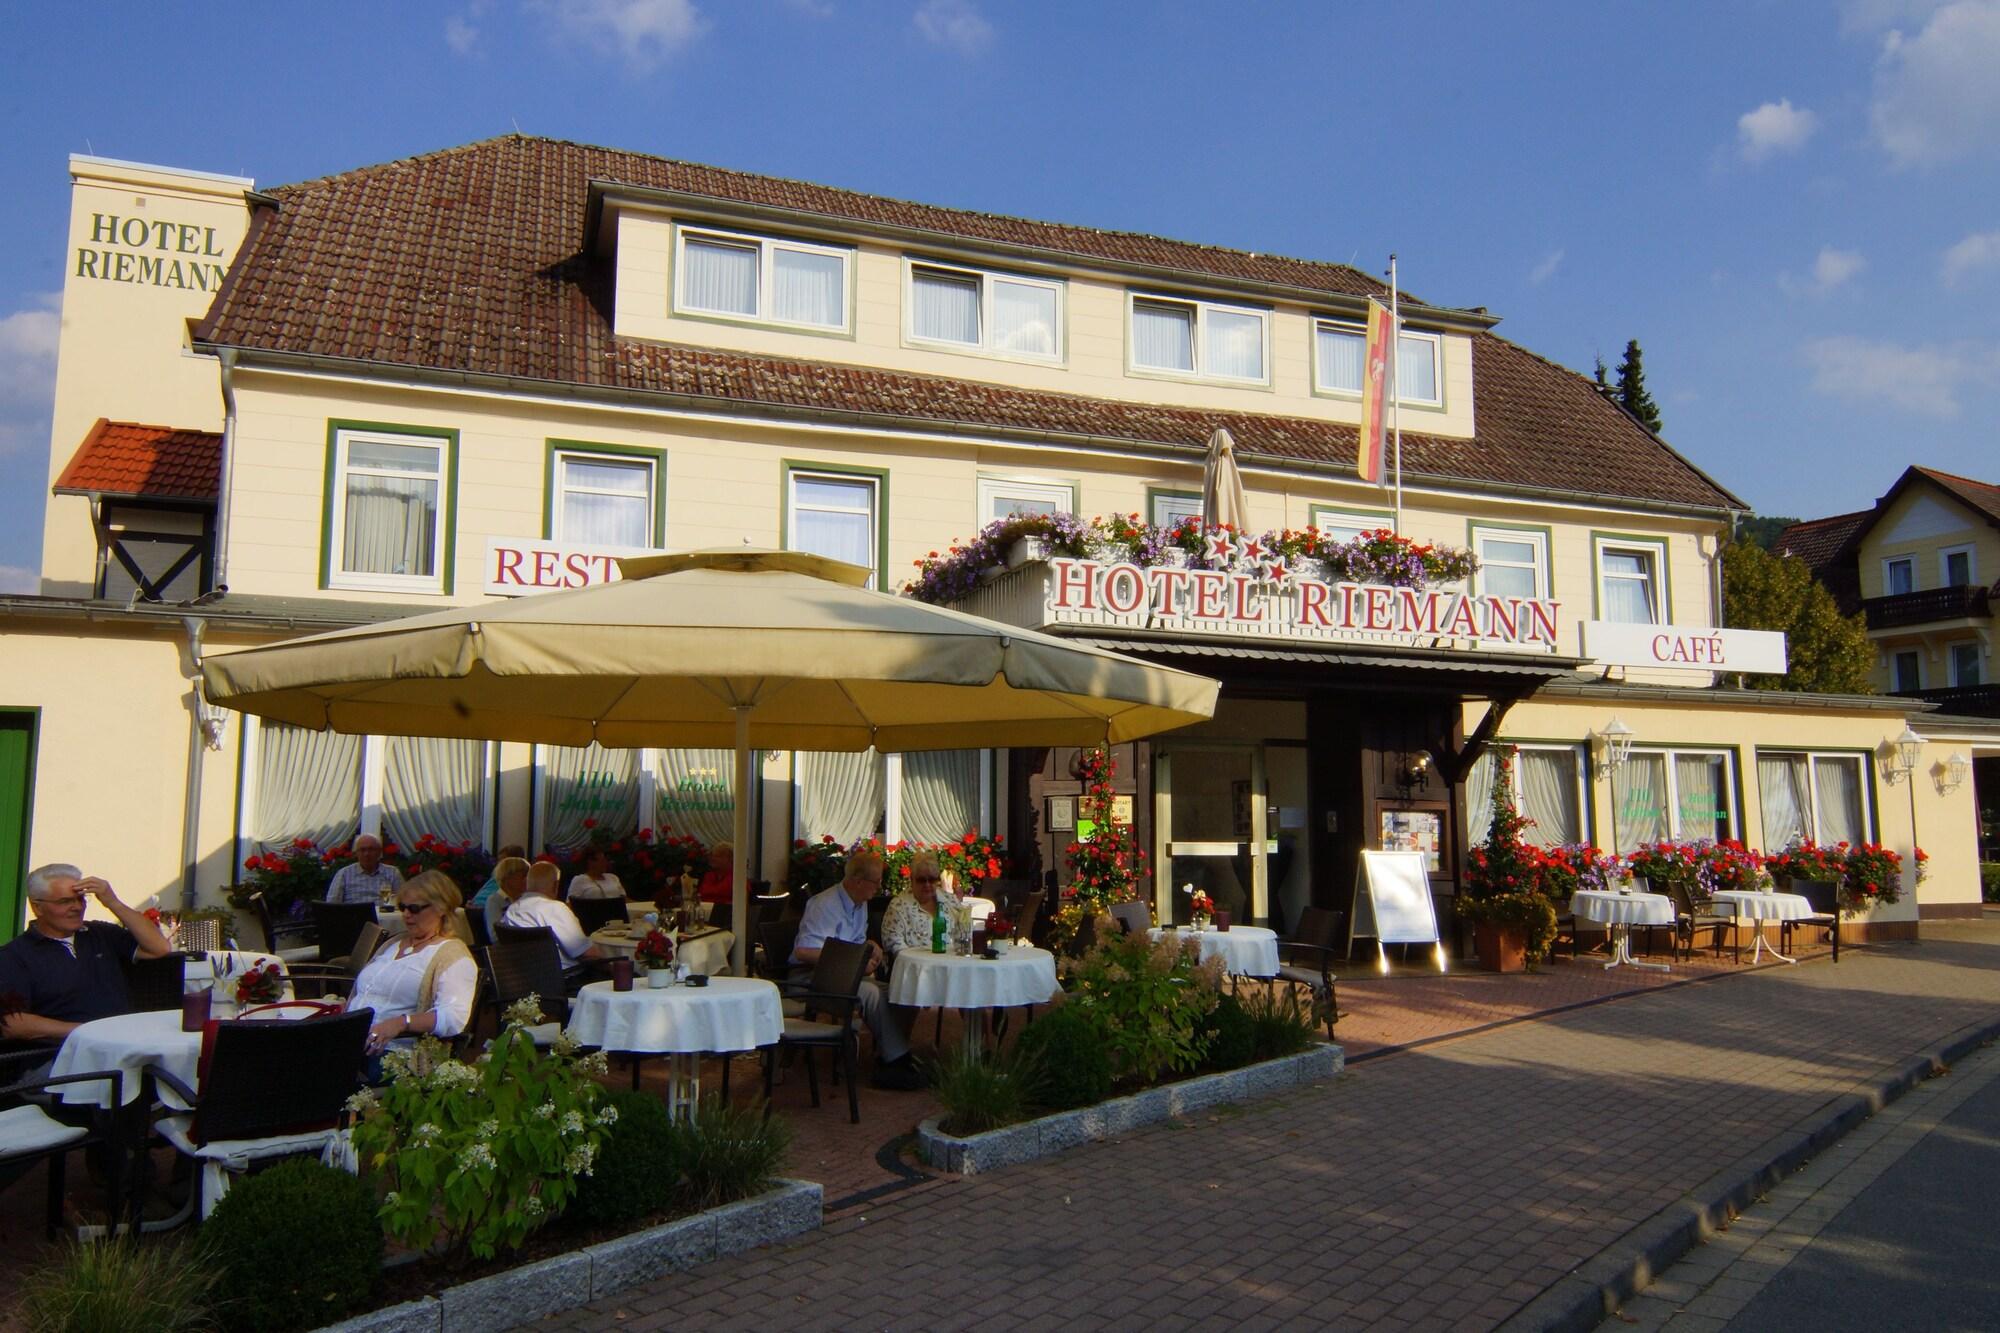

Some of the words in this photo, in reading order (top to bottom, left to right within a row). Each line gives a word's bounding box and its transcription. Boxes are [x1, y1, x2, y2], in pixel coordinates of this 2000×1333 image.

[90, 213, 224, 258] HOTEL
[492, 548, 624, 589] REST
[1054, 561, 1265, 622] HOTEL
[1297, 582, 1562, 642] RIEMANN
[1651, 630, 1725, 664] CAFÉ
[576, 769, 615, 789] 110
[678, 777, 727, 793] Hotel
